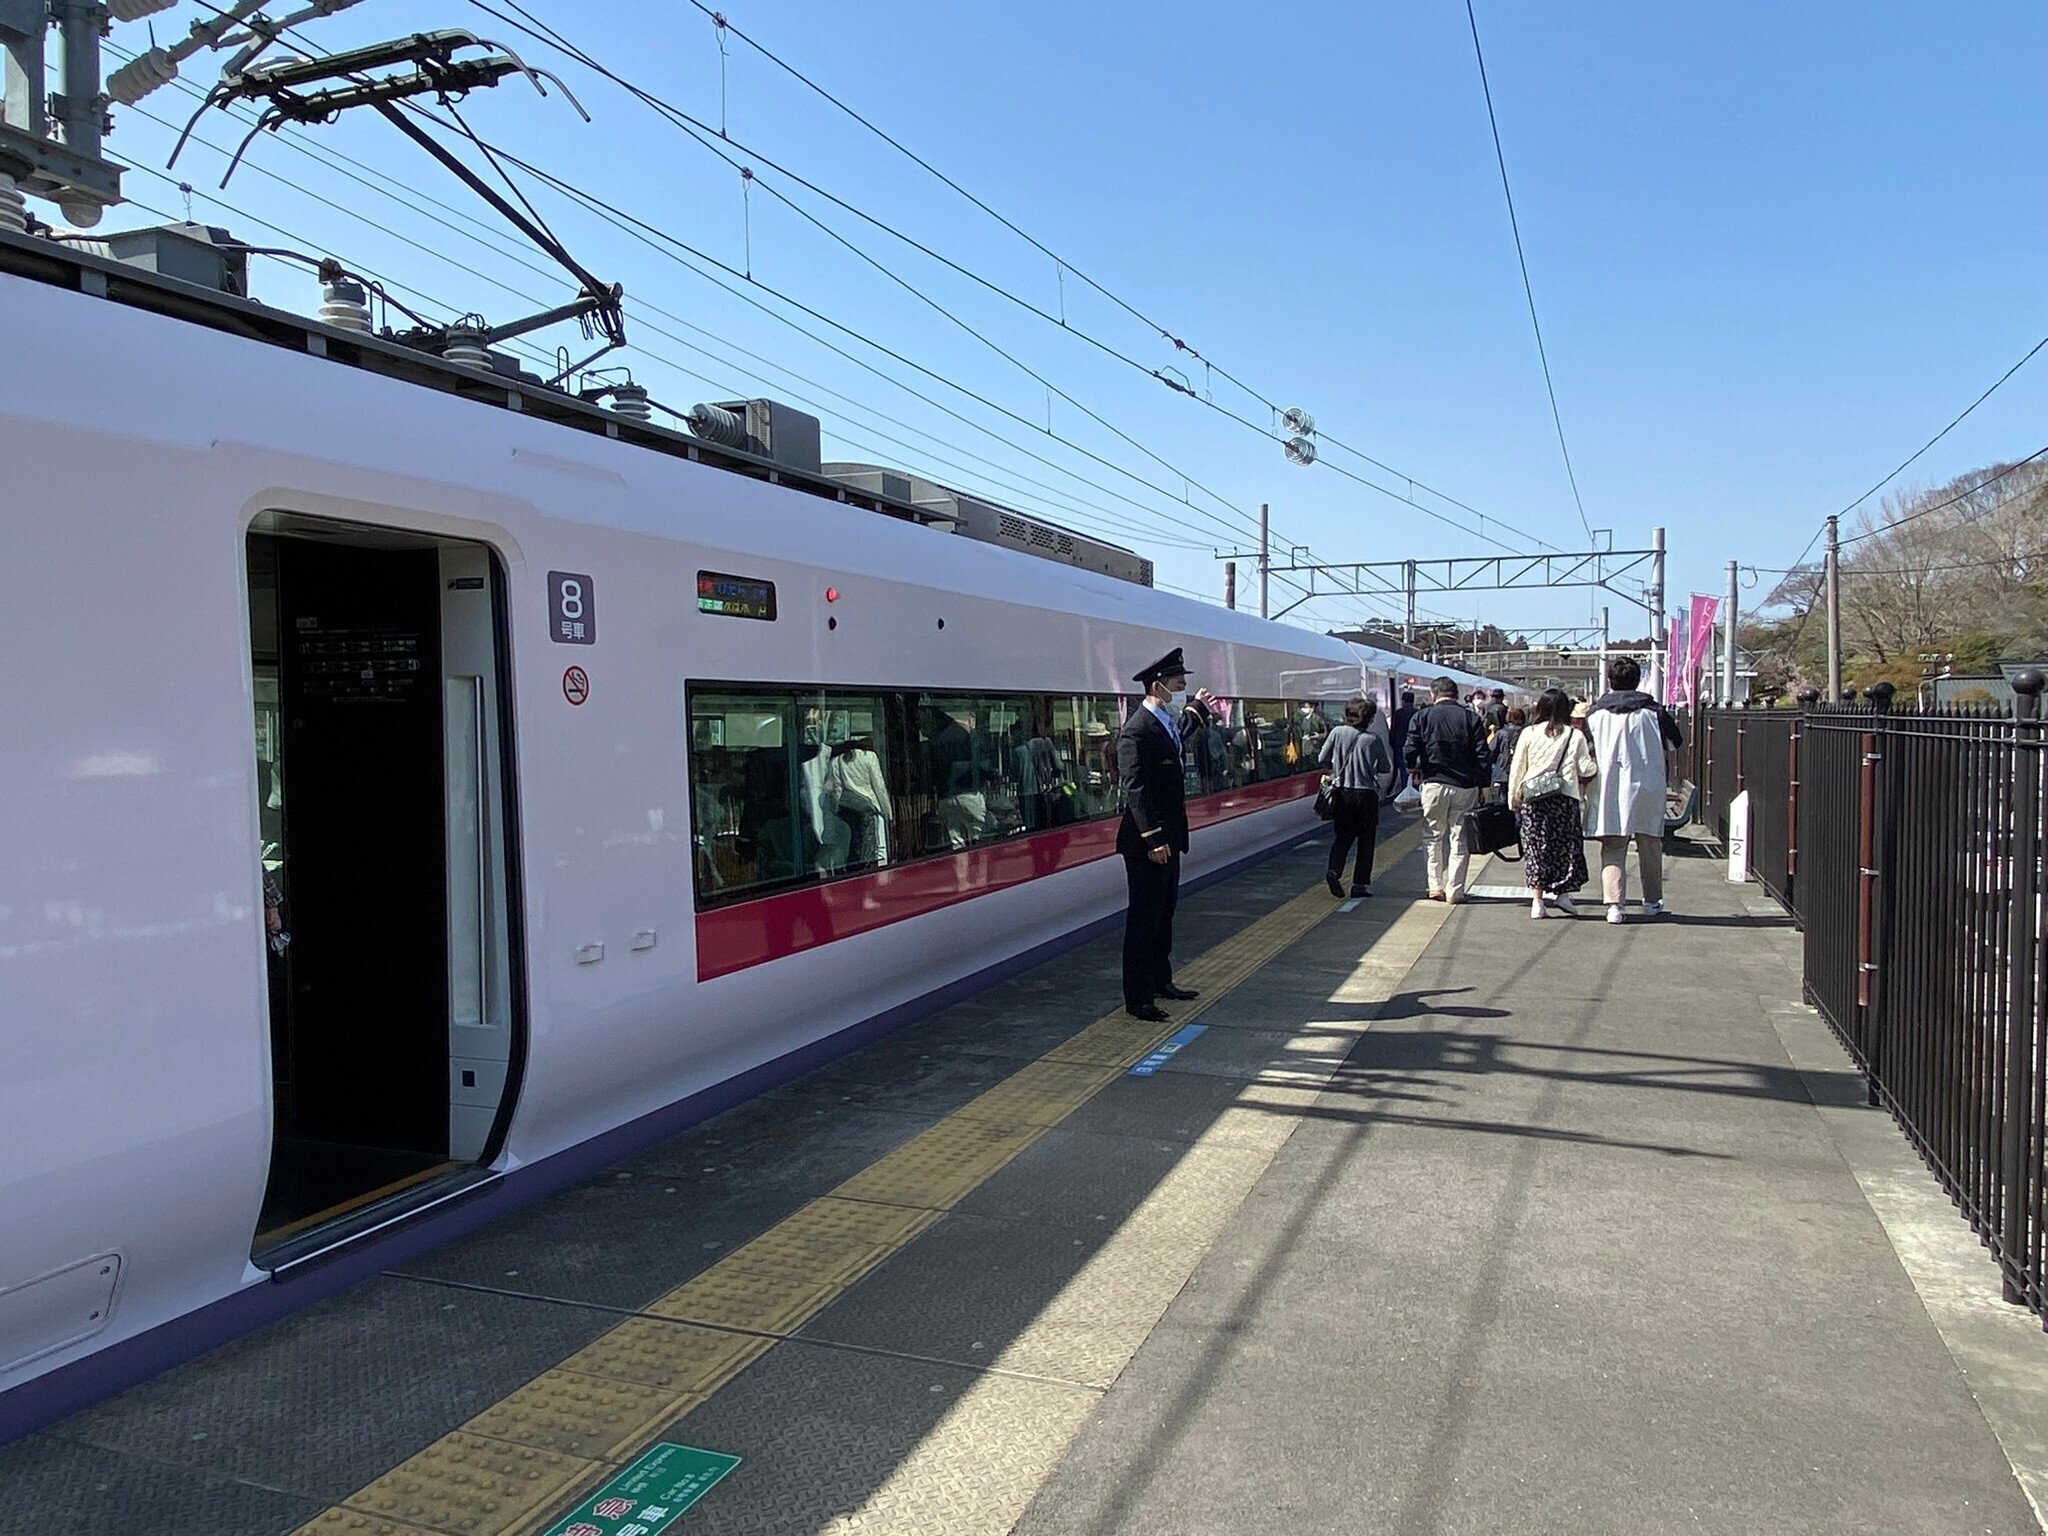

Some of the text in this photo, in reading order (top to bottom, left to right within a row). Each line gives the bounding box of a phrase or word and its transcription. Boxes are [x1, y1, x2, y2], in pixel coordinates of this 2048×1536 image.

[560, 579, 584, 619] 8
[560, 621, 586, 640] 号車
[1732, 842, 1742, 857] 2
[617, 1468, 648, 1492] Limited
[645, 1448, 677, 1472] Express
[660, 1485, 681, 1501] Car
